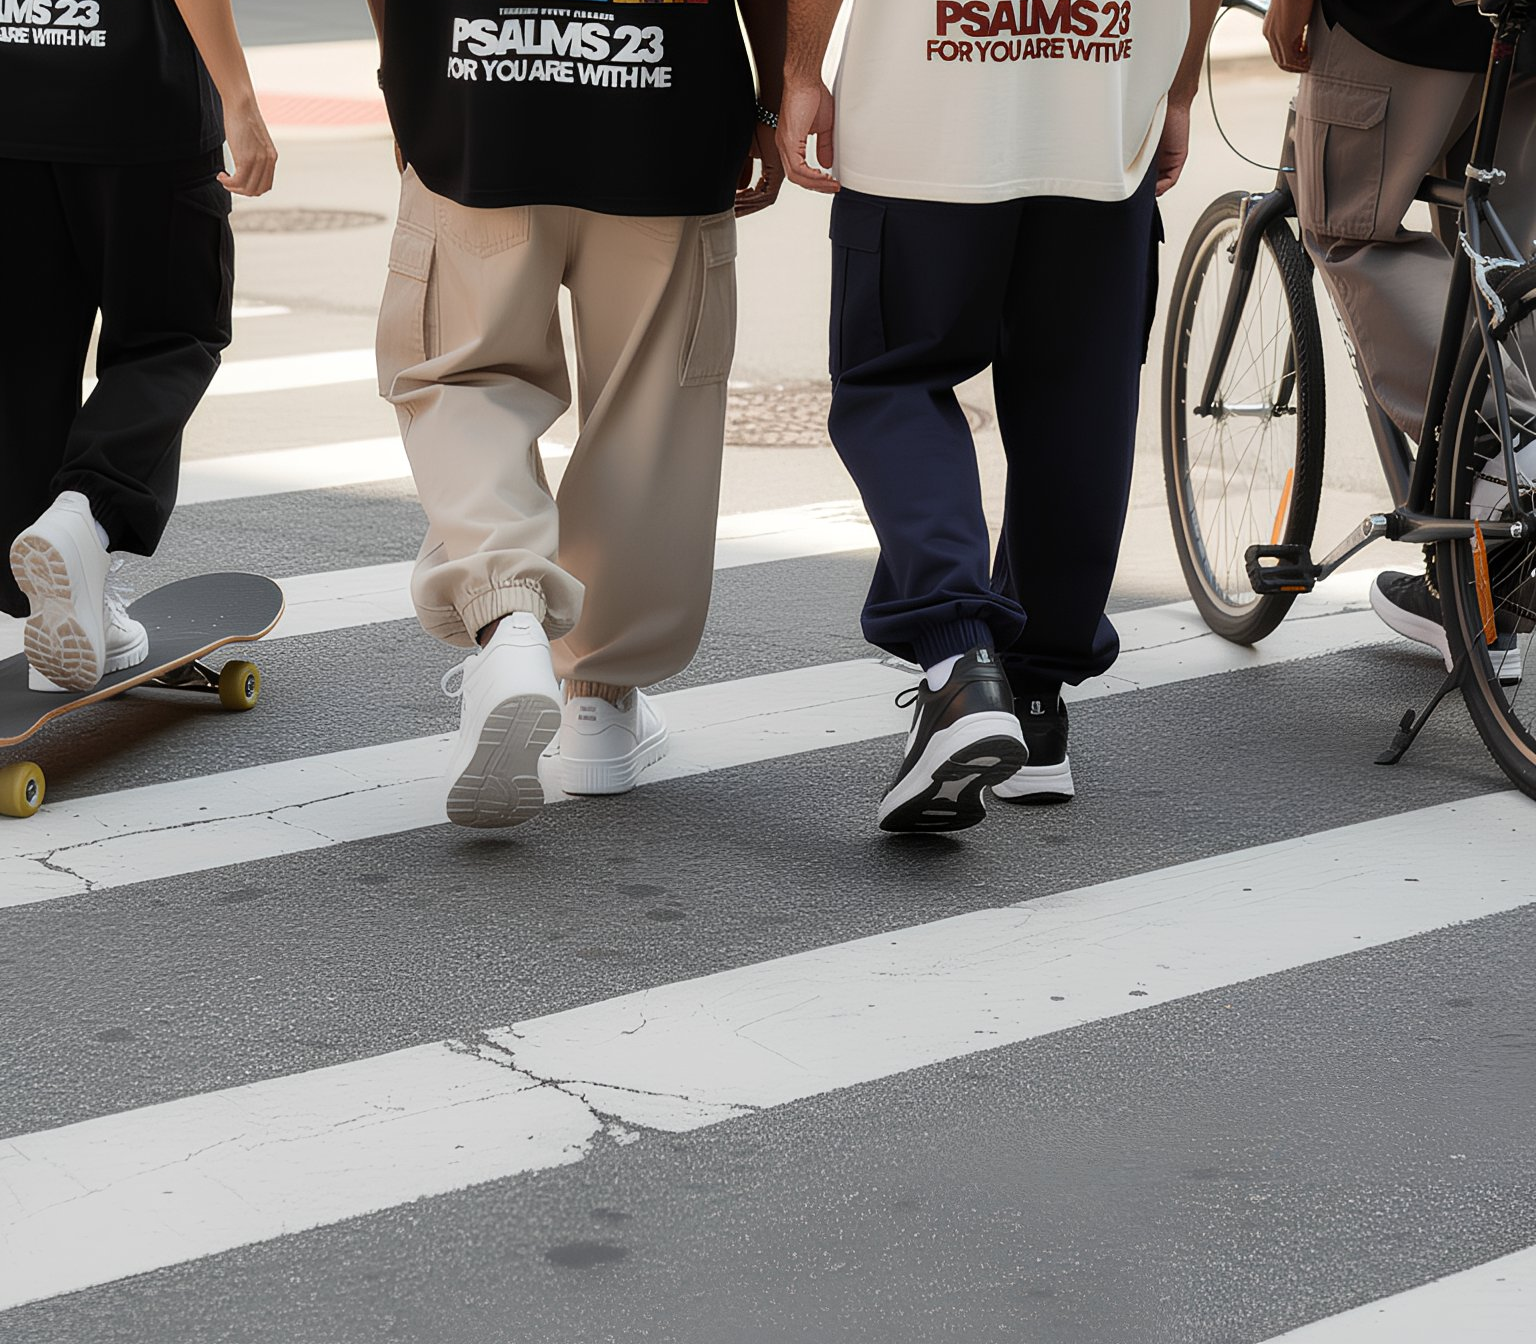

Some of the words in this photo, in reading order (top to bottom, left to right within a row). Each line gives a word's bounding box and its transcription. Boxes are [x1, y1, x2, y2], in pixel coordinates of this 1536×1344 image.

[1099, 0, 1132, 38] 23
[78, 29, 107, 47] ME
[452, 18, 610, 61] PSALMS
[611, 25, 664, 63] 23
[926, 39, 973, 63] FOR
[974, 38, 1022, 63] YOU
[1022, 37, 1066, 61] ARE
[481, 59, 528, 82] YOU
[528, 59, 575, 84] ARE
[577, 62, 639, 89] WITH
[640, 66, 672, 89] ME
